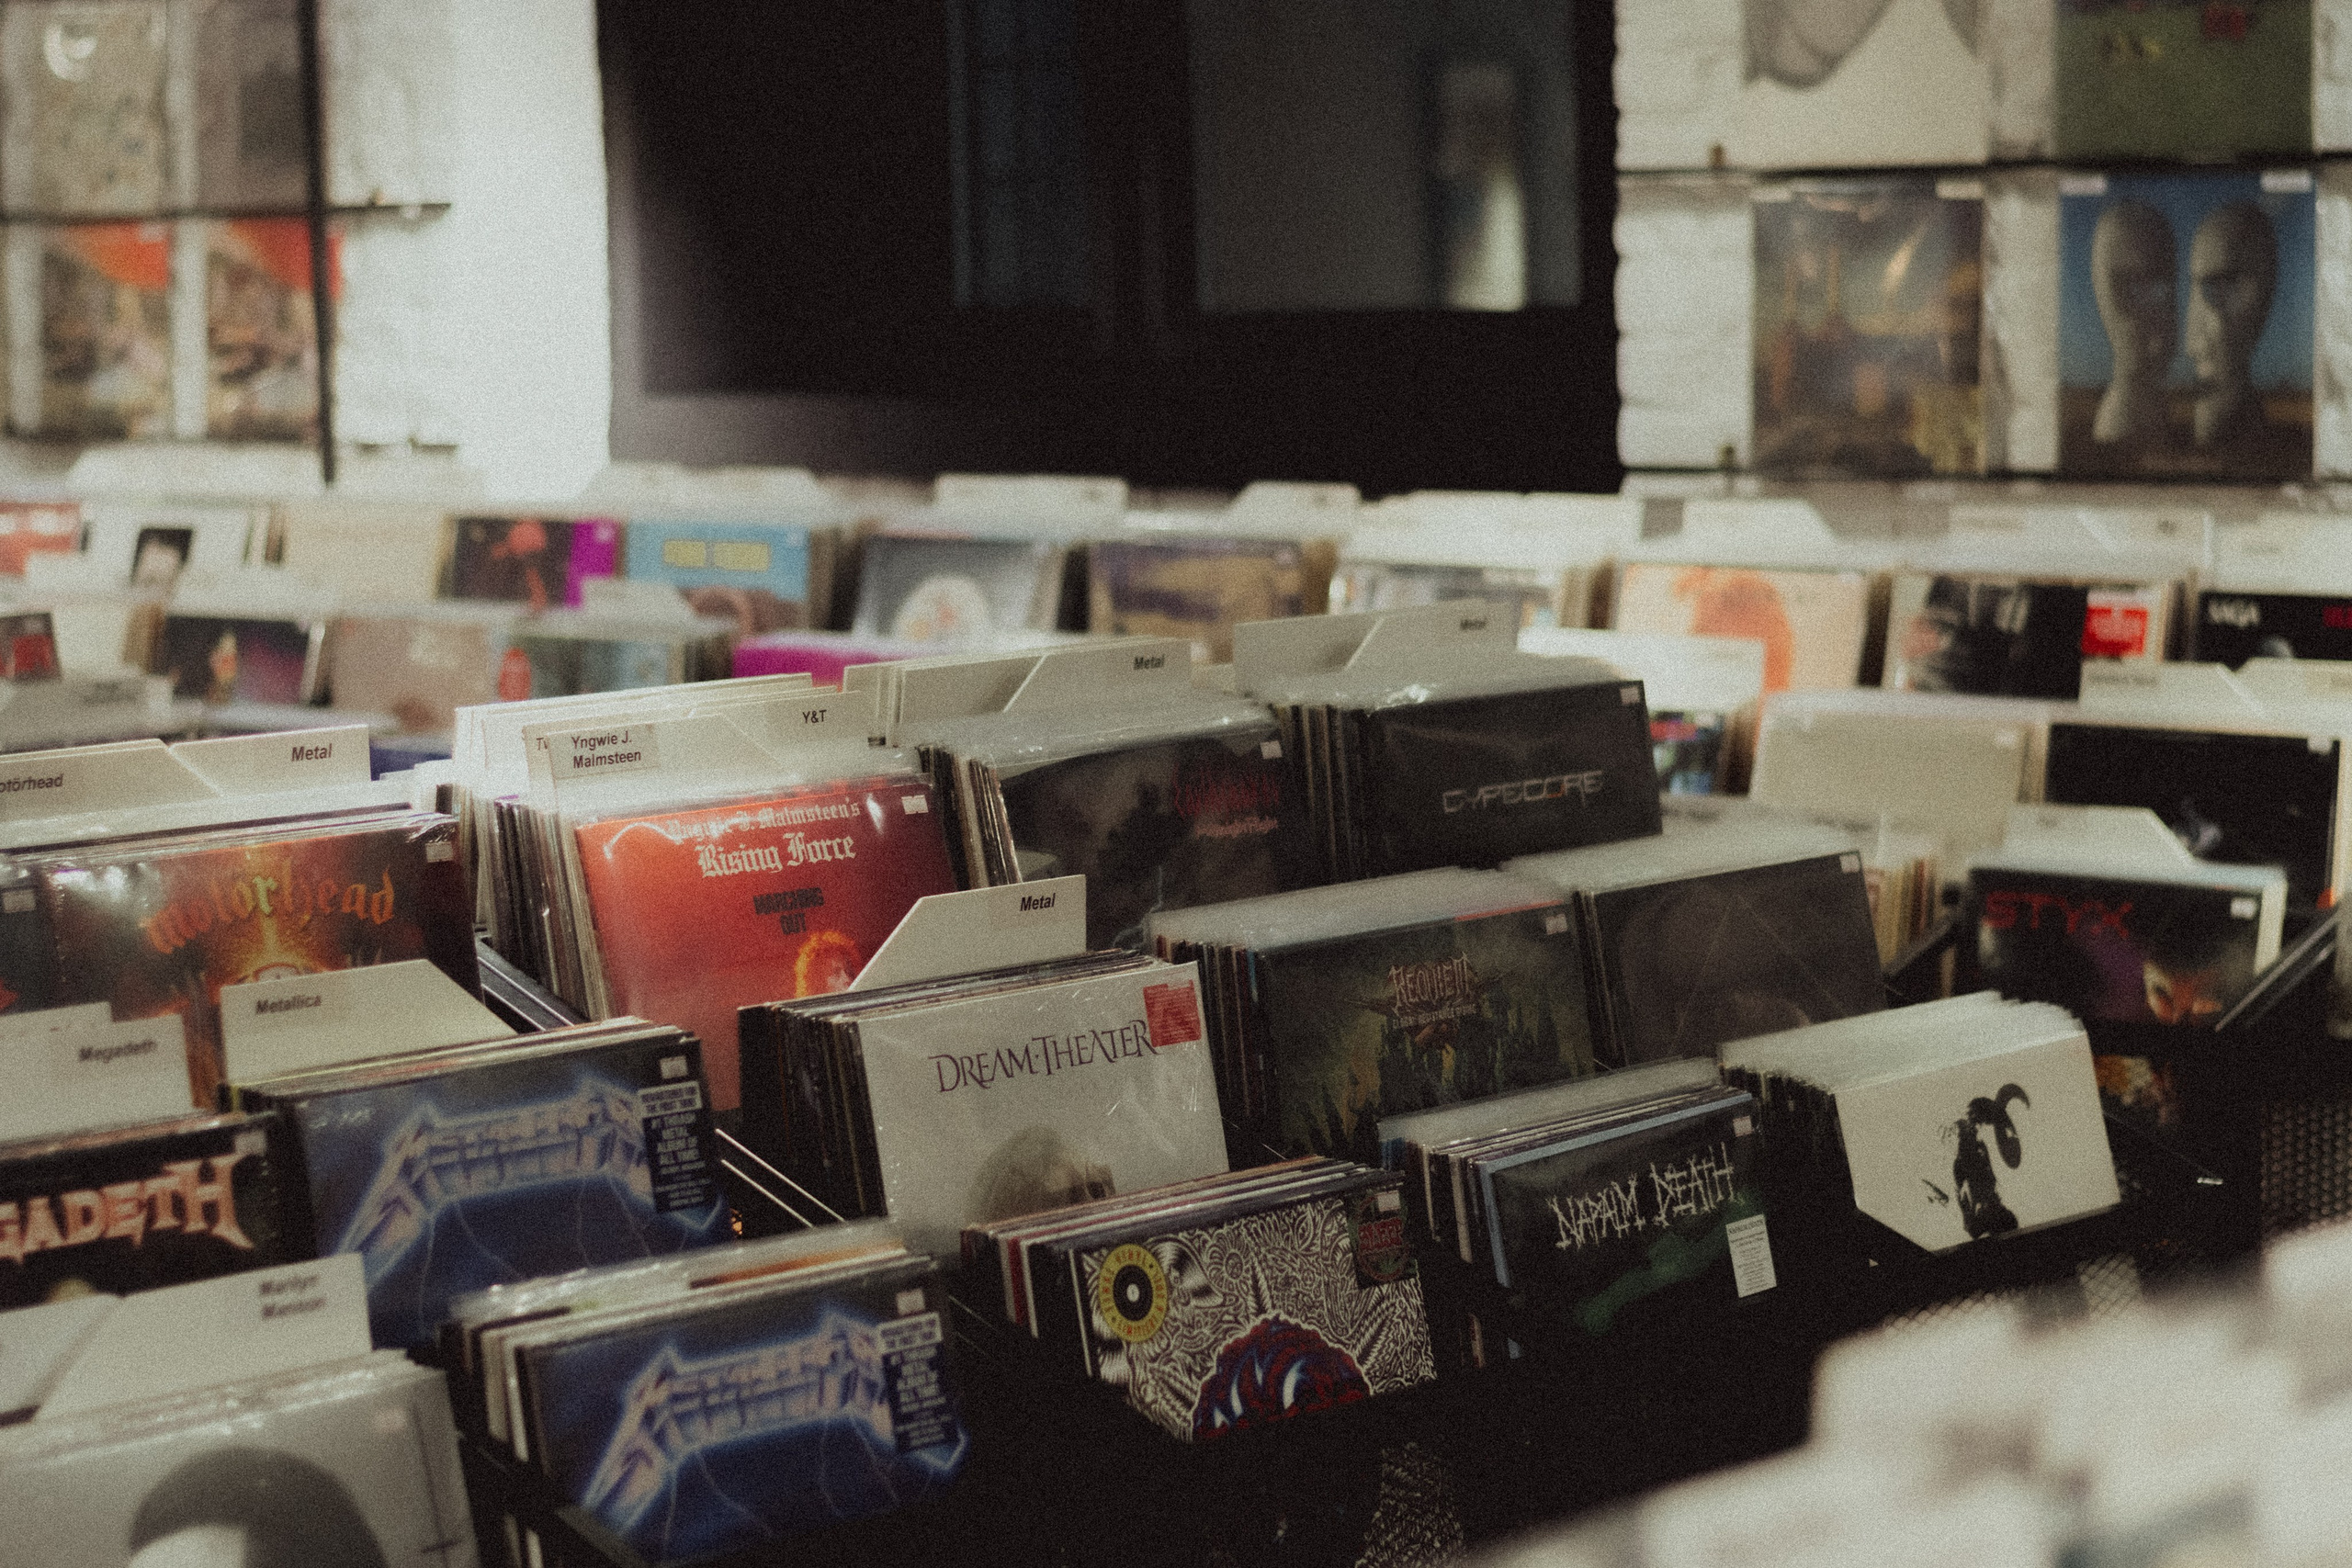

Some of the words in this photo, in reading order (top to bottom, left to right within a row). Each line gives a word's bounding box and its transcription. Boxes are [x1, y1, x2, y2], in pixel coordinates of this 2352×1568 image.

[1133, 653, 1165, 671] Metal
[802, 709, 827, 724] Y&T
[571, 733, 618, 751] Yngwie
[621, 729, 632, 744] J.
[290, 742, 333, 762] Metal
[572, 750, 641, 769] Malmsteen
[697, 842, 783, 878] Rising
[783, 831, 857, 867] Force
[752, 886, 825, 917] MARCHING
[1020, 892, 1056, 912] Metal
[778, 911, 808, 935] OUT
[1985, 891, 2133, 940] STYX
[255, 995, 322, 1016] Metallica
[1546, 1173, 1645, 1251] NAPALM
[1650, 1142, 1735, 1229] DEATH
